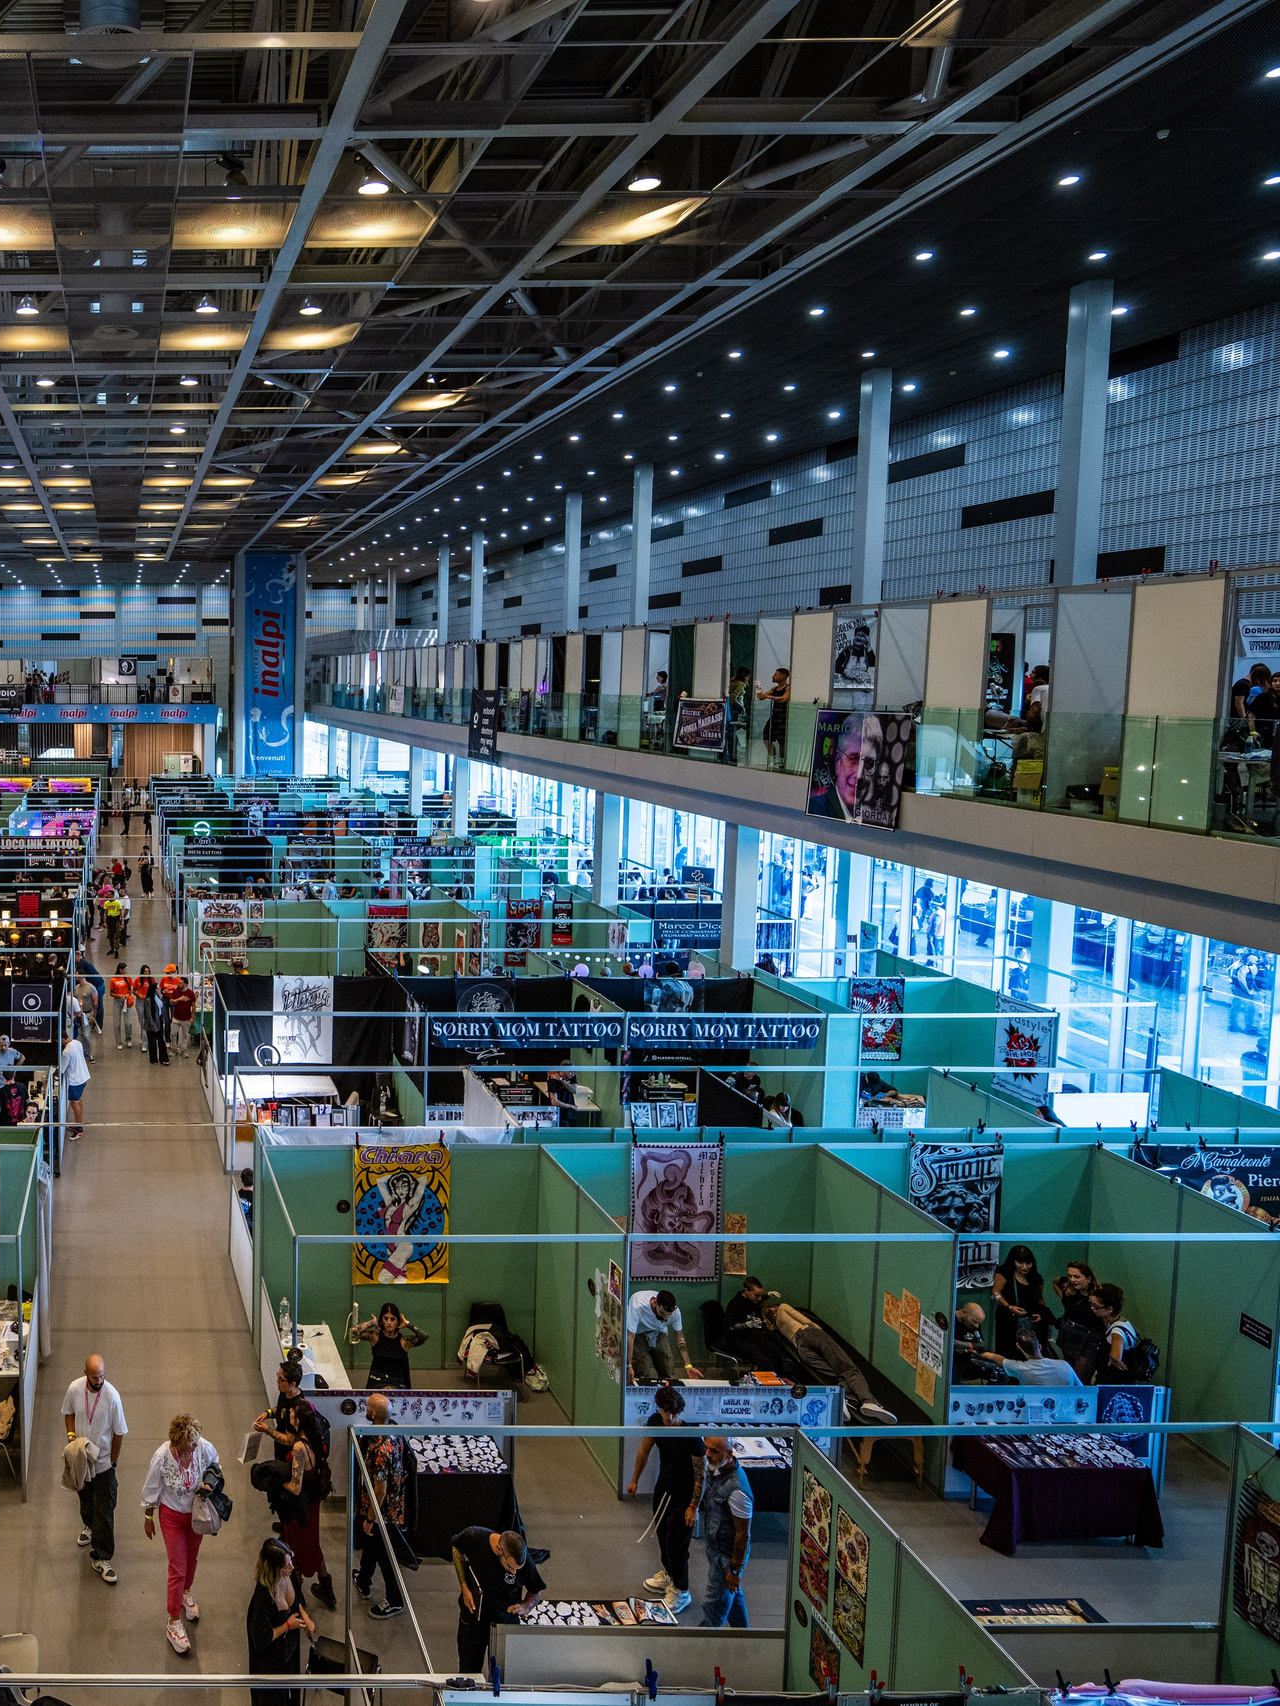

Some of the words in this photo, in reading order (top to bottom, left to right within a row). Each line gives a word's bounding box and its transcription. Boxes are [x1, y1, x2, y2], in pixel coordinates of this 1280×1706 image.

[253, 608, 285, 698] inalpi
[59, 707, 88, 719] inalpi
[110, 707, 138, 719] inalpi
[160, 707, 189, 719] inalpi
[817, 721, 852, 734] MARIO
[251, 754, 286, 762] Benvenuti
[509, 901, 540, 915] SARA
[658, 922, 695, 930] Marco
[360, 1146, 443, 1164] Chiara
[720, 1407, 752, 1415] WELCOME
